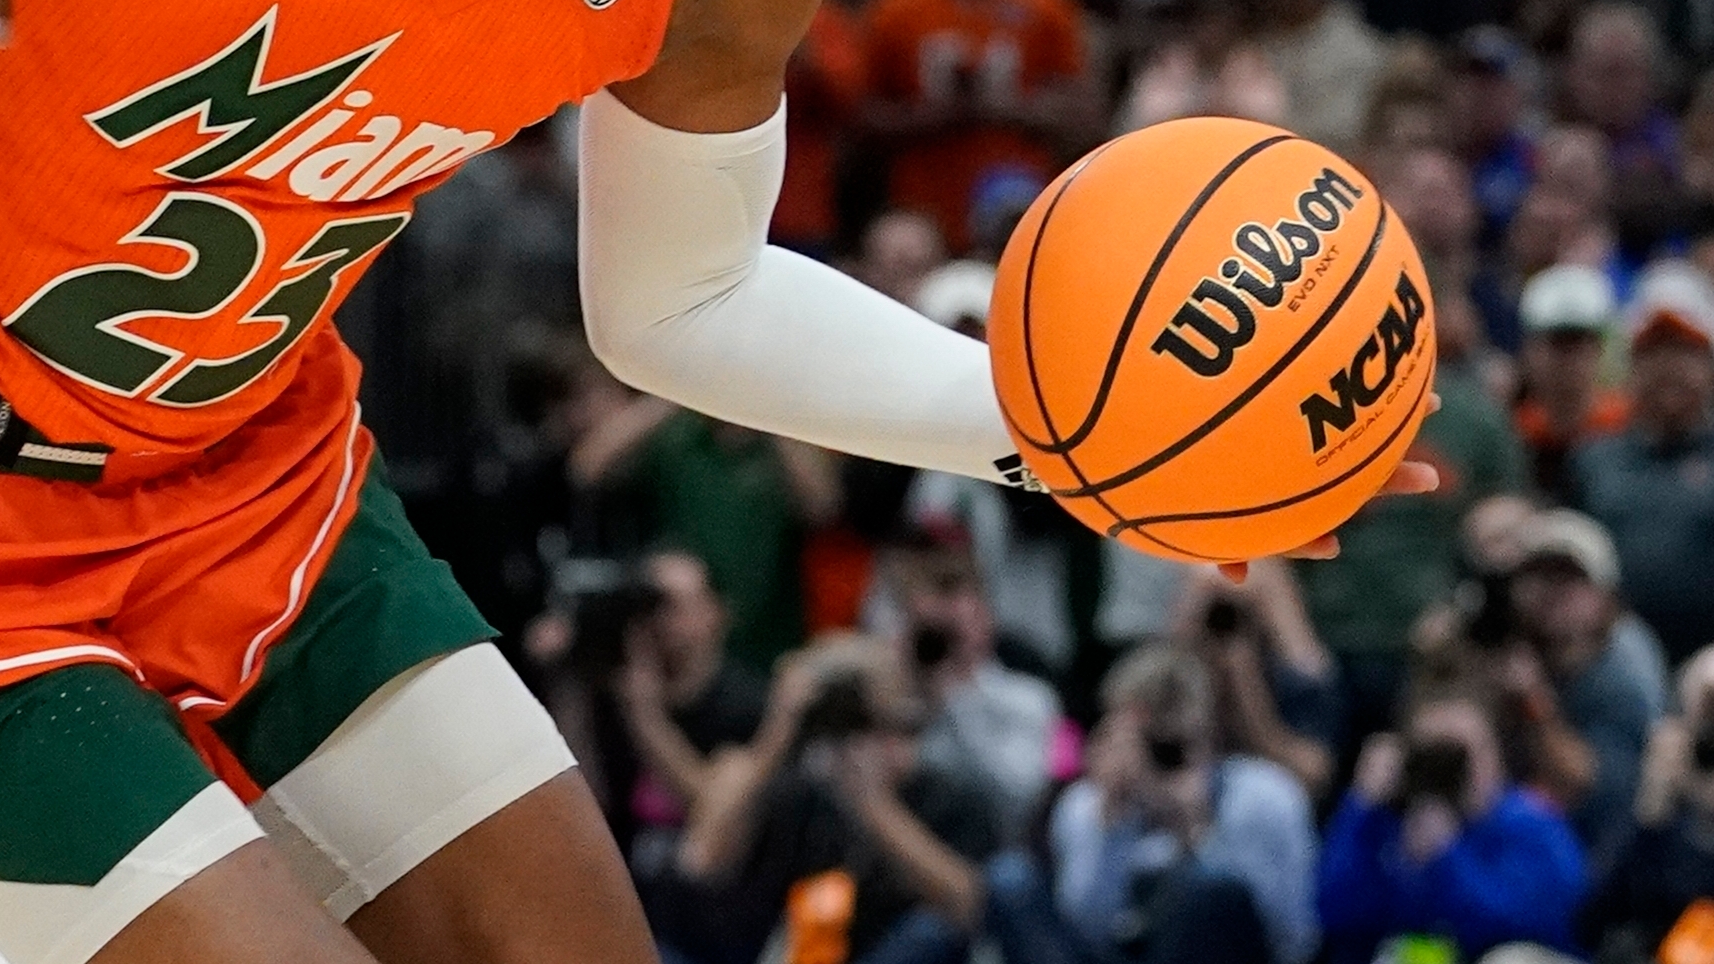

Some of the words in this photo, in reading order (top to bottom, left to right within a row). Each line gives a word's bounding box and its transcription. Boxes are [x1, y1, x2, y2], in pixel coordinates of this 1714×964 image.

[83, 3, 496, 202] Miam
[3, 191, 412, 408] 23
[1150, 166, 1364, 378] Wilson
[1287, 278, 1317, 313] EVO
[1315, 244, 1341, 278] NXT
[1299, 269, 1424, 454] NCAA
